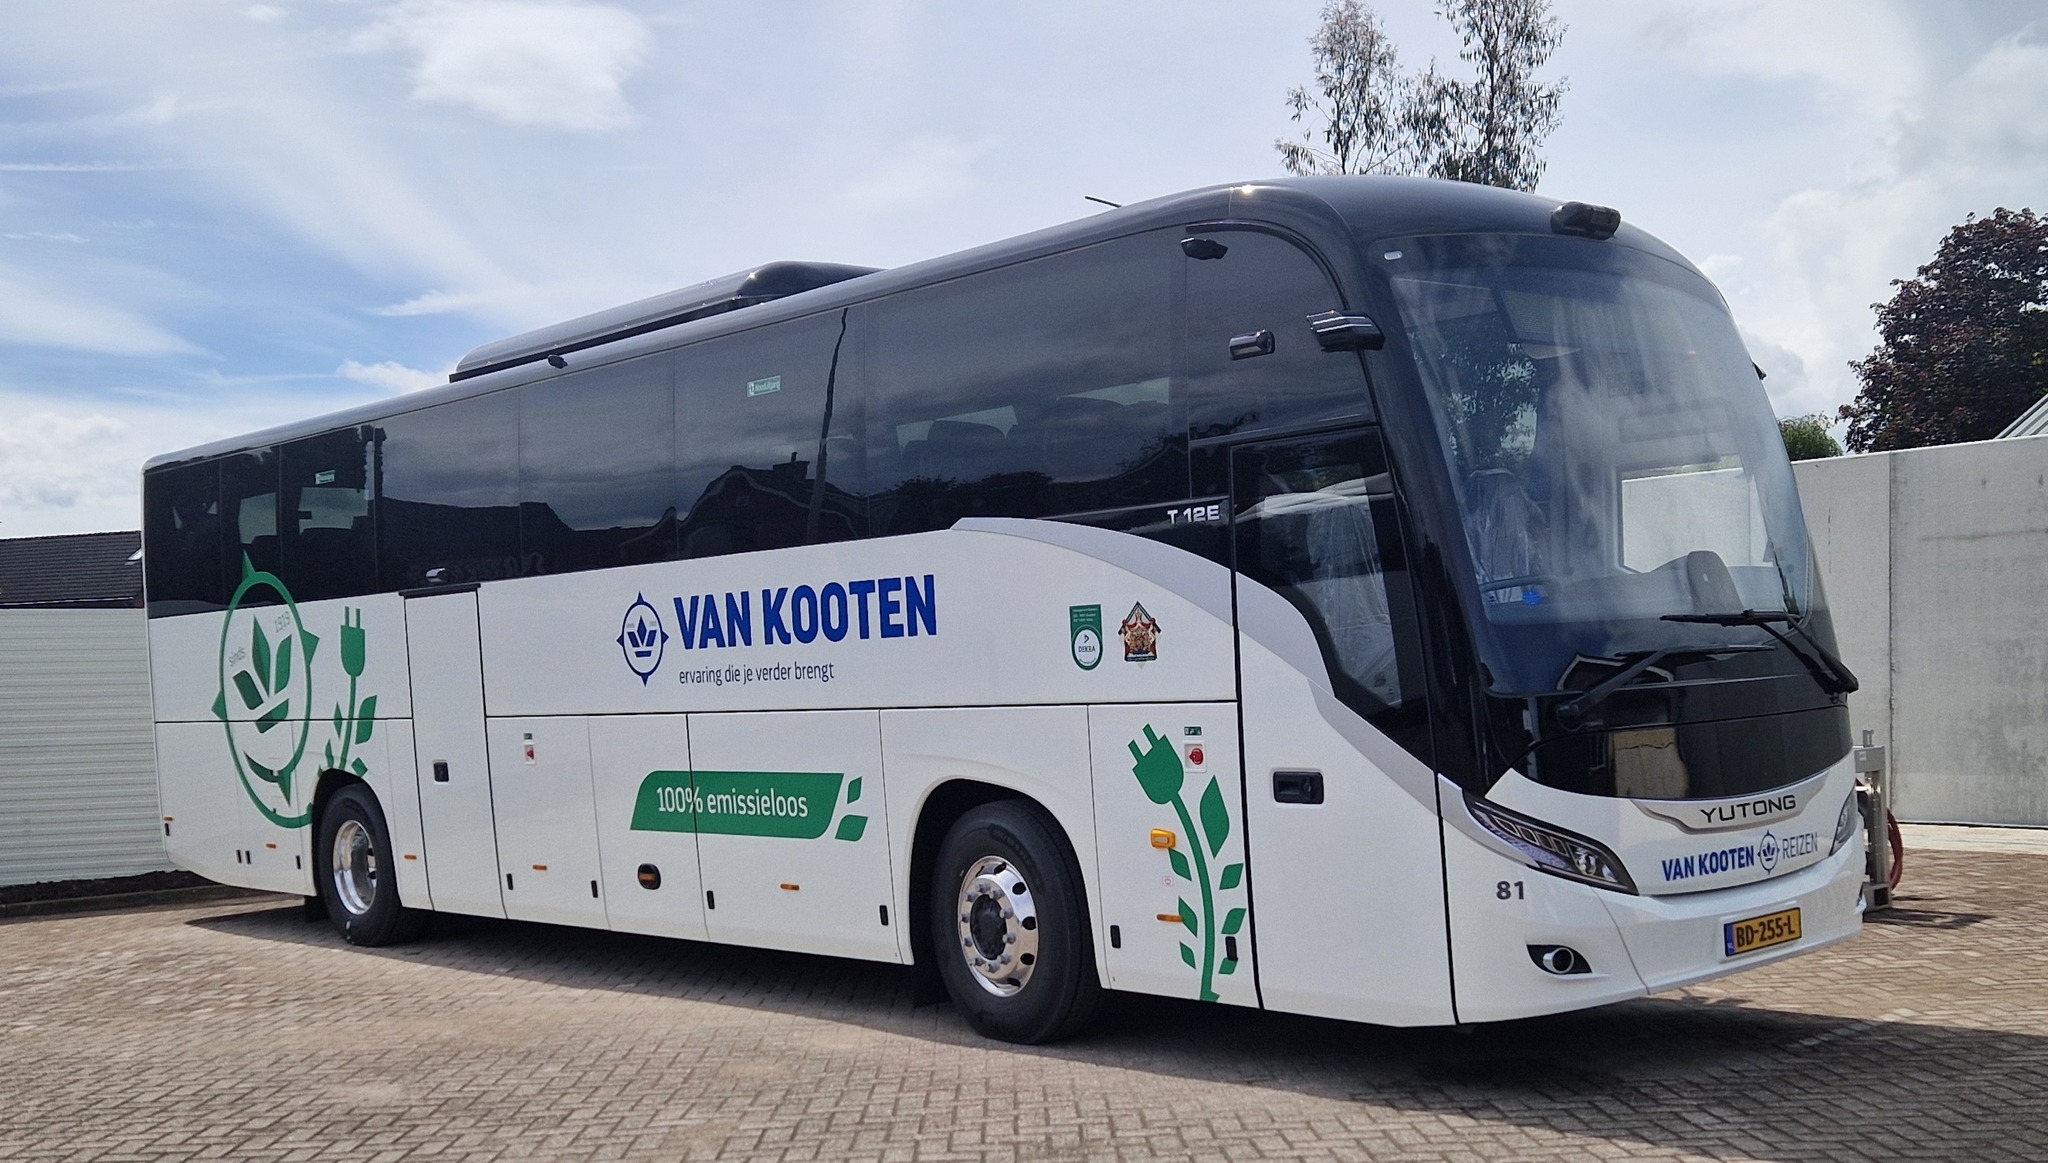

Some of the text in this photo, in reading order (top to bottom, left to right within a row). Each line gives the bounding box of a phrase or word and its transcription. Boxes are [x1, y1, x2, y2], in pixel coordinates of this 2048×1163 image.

[1167, 505, 1220, 524] T 12E
[673, 574, 937, 649] VAN KOOTEN
[1078, 645, 1096, 653] DEKRA
[679, 661, 834, 686] ervaring die je verder brengt
[656, 786, 809, 817] 100% emissieloos
[1700, 794, 1797, 823] YUTONG
[1662, 832, 1818, 881] VAN KOOTEN REIZEN
[1496, 880, 1524, 900] 81
[1736, 915, 1796, 948] BD-255-L
